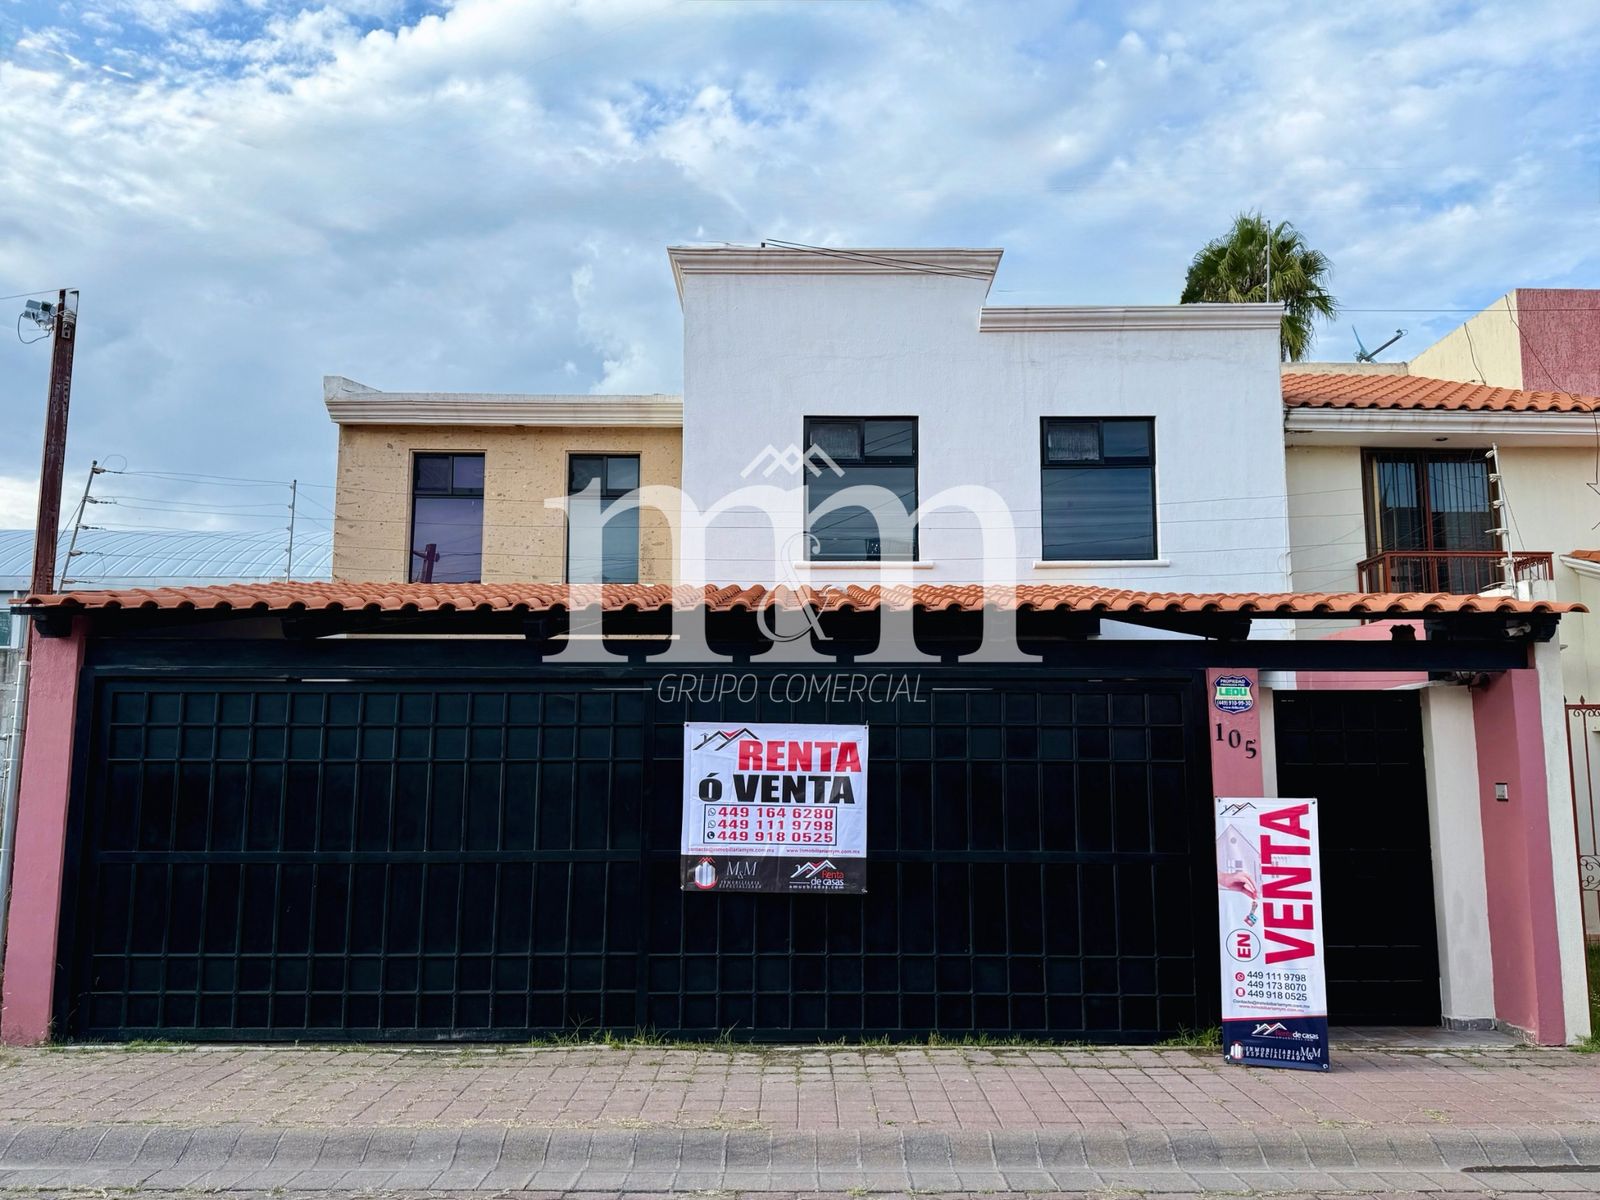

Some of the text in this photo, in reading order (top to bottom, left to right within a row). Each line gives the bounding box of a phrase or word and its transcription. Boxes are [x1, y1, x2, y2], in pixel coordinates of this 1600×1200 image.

[1218, 687, 1248, 696] LEDU
[1215, 722, 1257, 760] 105
[738, 740, 862, 773] RENTA
[698, 772, 856, 804] Ó VENTA
[718, 807, 834, 819] 449 164 6280
[717, 819, 834, 831] 449 111 9798
[717, 831, 834, 843] 449 918 0525
[726, 861, 758, 880] M&M
[821, 870, 845, 879] Renta
[811, 877, 845, 886] de casas
[1259, 803, 1316, 965] VENTA
[1237, 933, 1251, 959] EN
[1247, 971, 1307, 982] 449 111 9798
[1247, 980, 1307, 992] 449 173 8070
[1248, 990, 1308, 1002] 449 918 0525
[1292, 1031, 1302, 1039] de
